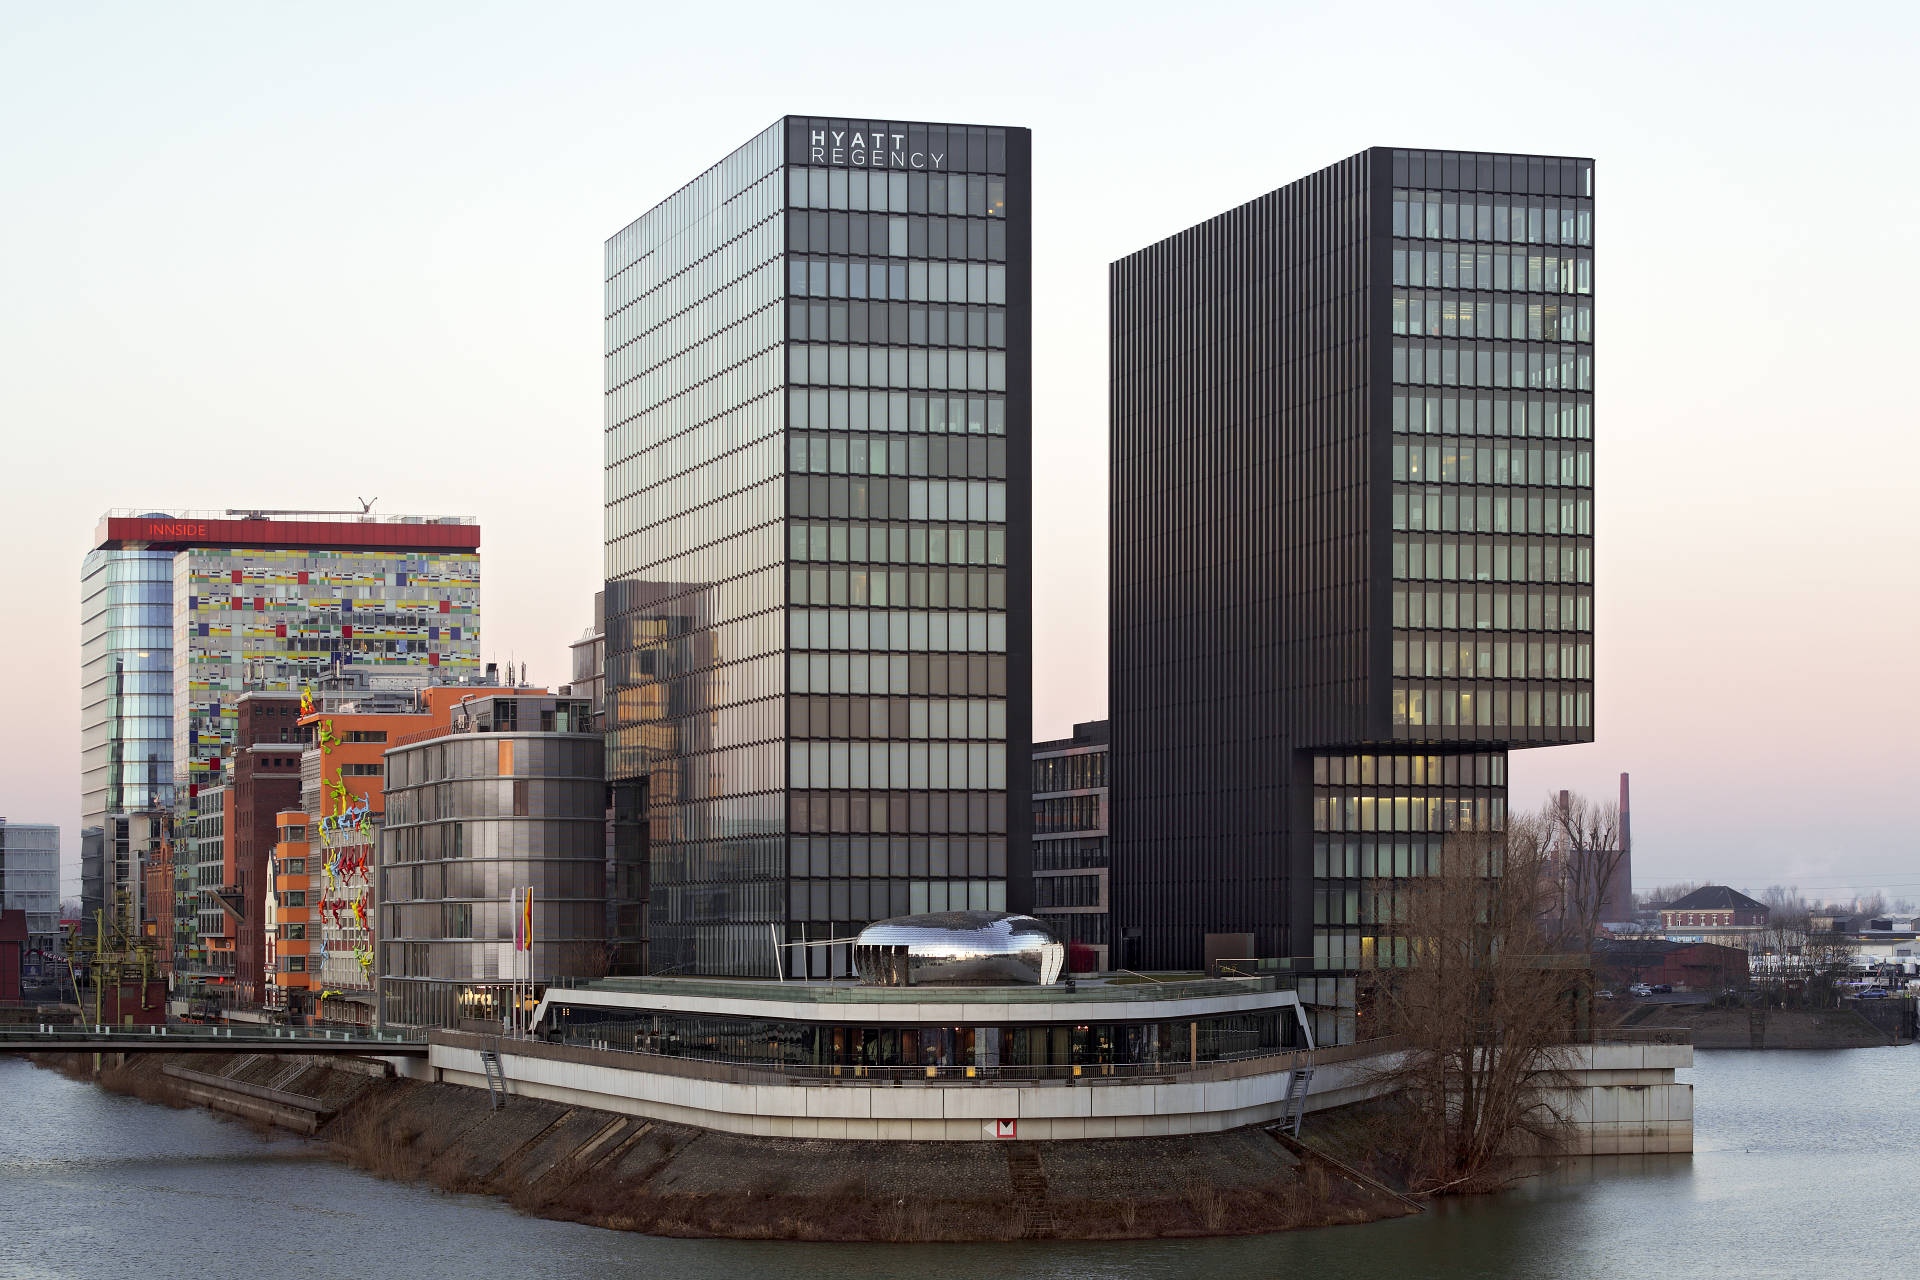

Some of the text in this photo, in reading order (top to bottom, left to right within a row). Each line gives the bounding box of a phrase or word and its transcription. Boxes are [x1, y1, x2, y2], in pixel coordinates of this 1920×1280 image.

[812, 130, 904, 150] HYATT
[812, 147, 944, 168] REGENCY
[150, 523, 208, 537] INNSIDE
